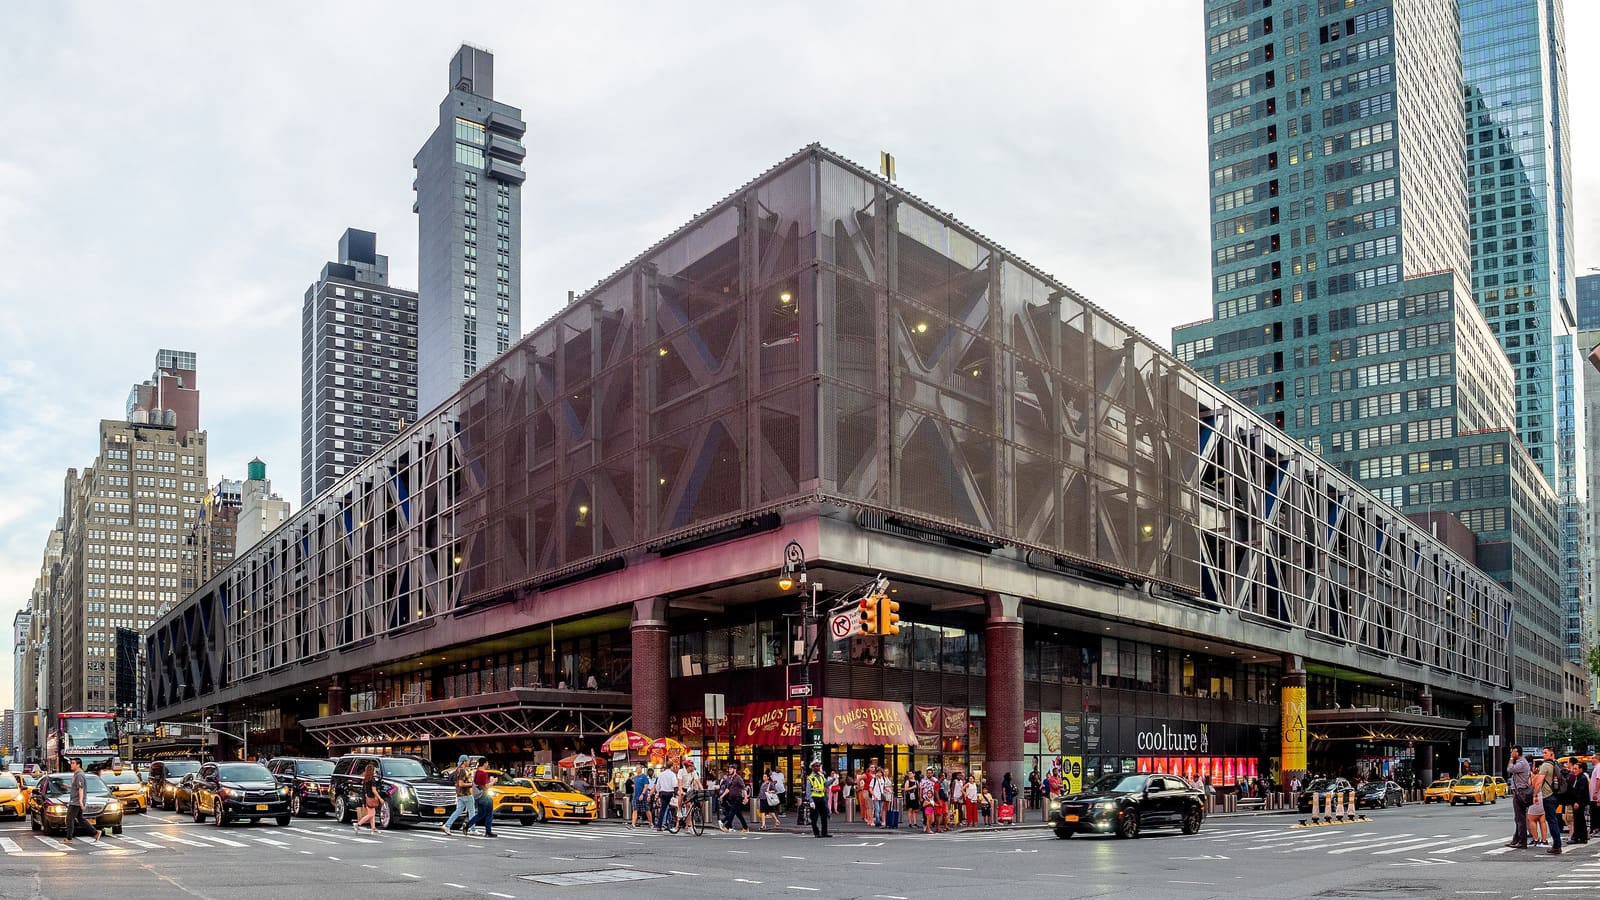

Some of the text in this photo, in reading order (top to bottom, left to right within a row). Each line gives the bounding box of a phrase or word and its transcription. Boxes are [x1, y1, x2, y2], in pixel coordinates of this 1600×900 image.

[747, 708, 784, 736] CARLO'S
[833, 707, 868, 734] CARLO'S
[869, 707, 900, 721] BAKE
[872, 721, 903, 736] SHOP
[1137, 724, 1197, 751] coolture
[1285, 728, 1304, 742] CT
